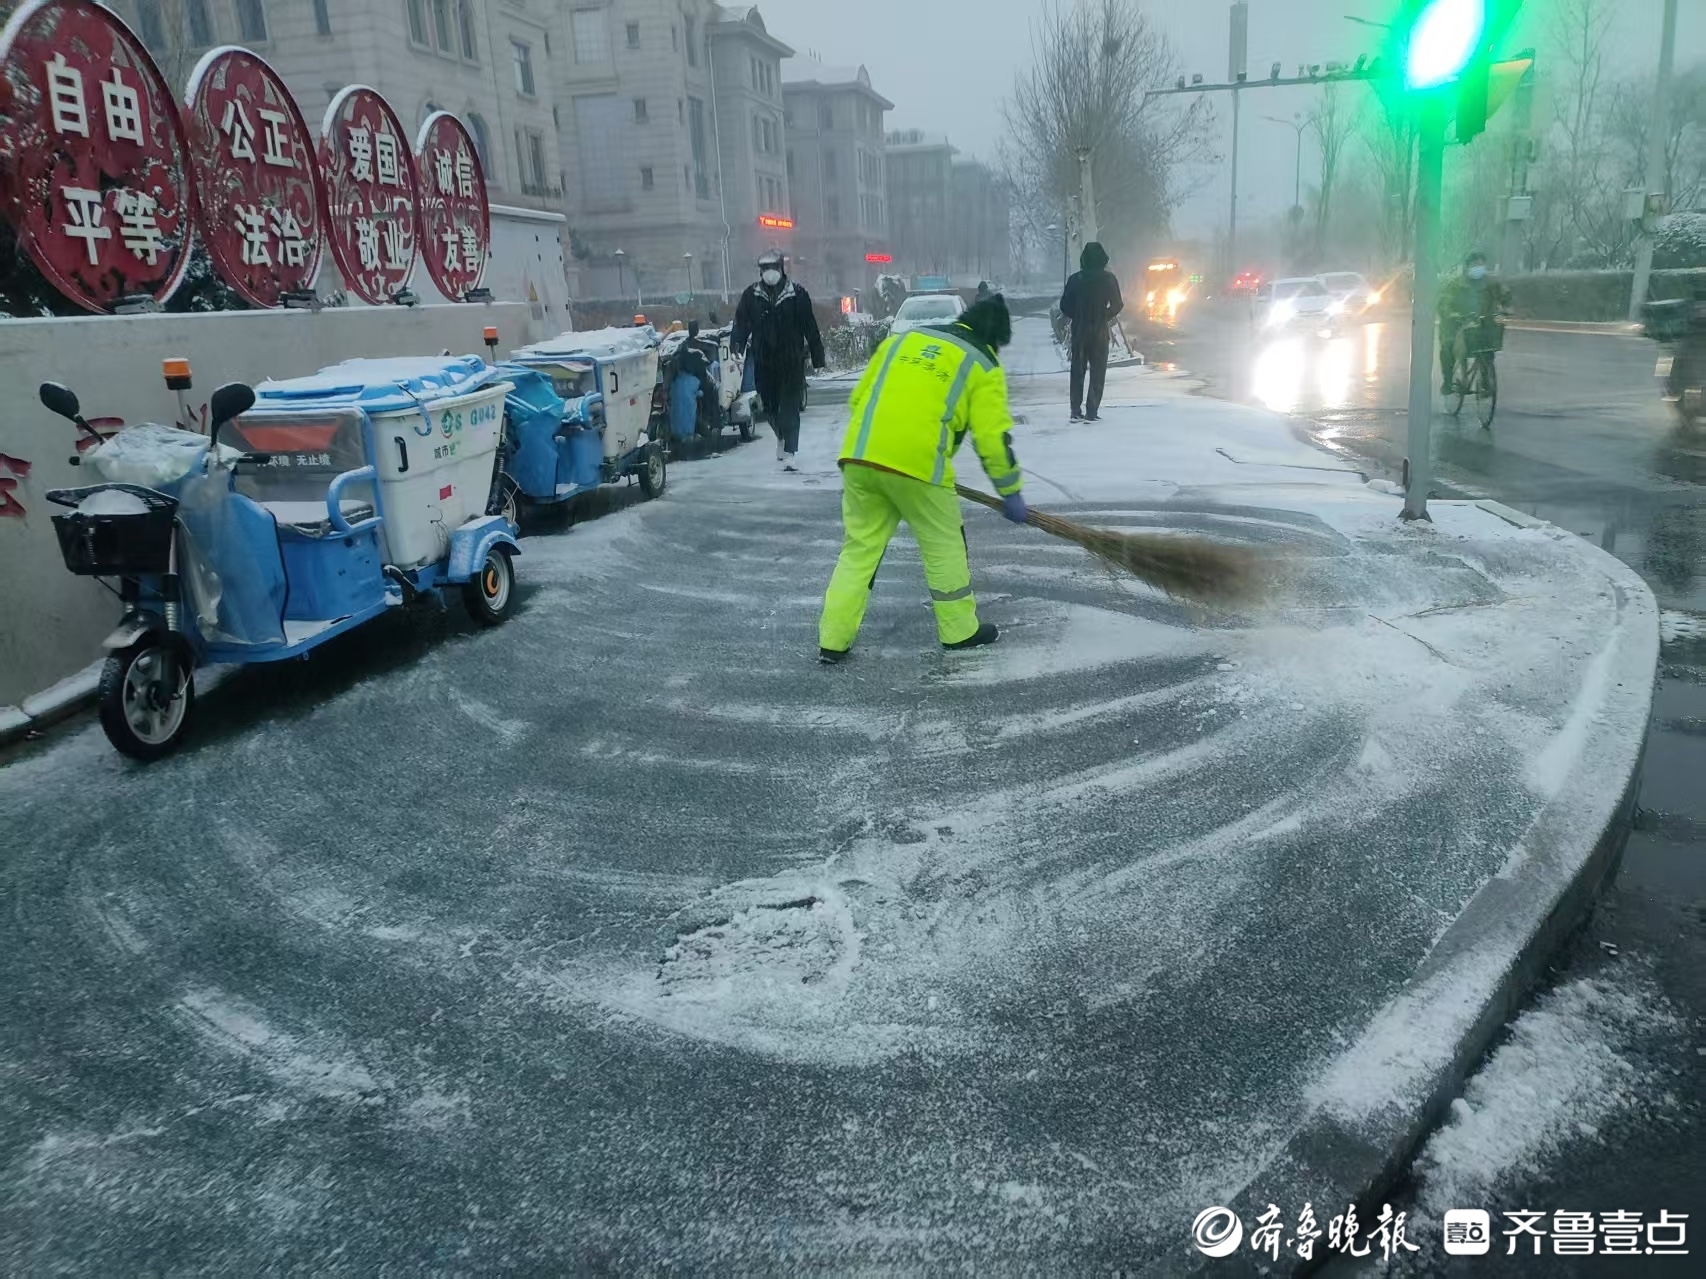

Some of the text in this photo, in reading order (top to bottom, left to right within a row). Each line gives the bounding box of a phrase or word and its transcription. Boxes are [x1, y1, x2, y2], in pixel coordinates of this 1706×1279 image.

[46, 51, 144, 147] 自由
[220, 98, 294, 168] 公正
[347, 126, 400, 188] 爱国
[434, 148, 474, 199] 诚信
[60, 185, 166, 266] 平等
[233, 204, 306, 268] 法治
[354, 216, 408, 272] 敬业
[441, 224, 480, 273] 友善
